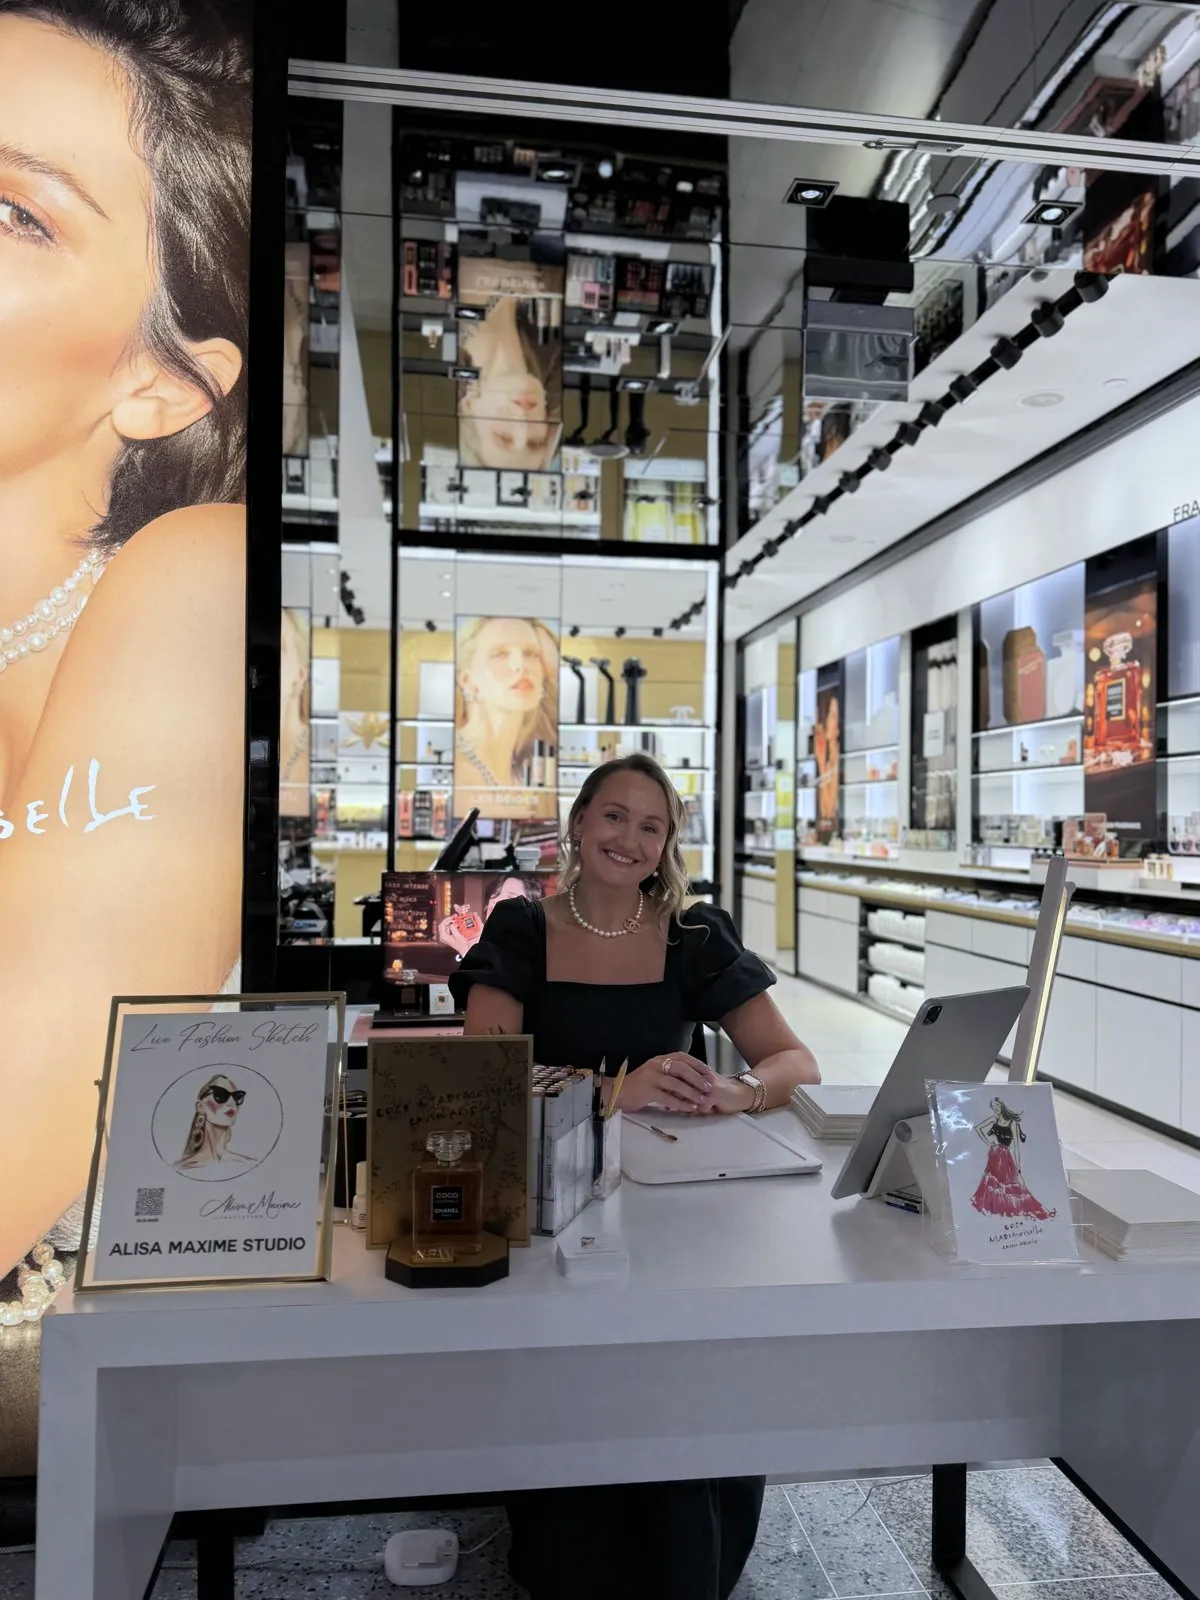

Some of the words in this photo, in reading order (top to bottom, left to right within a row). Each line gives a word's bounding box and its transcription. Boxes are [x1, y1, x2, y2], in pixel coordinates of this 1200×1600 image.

[178, 1021, 241, 1052] Fashion
[248, 1020, 319, 1051] Sketch
[109, 1242, 162, 1257] ALISA
[168, 1239, 238, 1255] MAXIME
[242, 1236, 307, 1253] STUDIO
[416, 1248, 453, 1259] NEW
